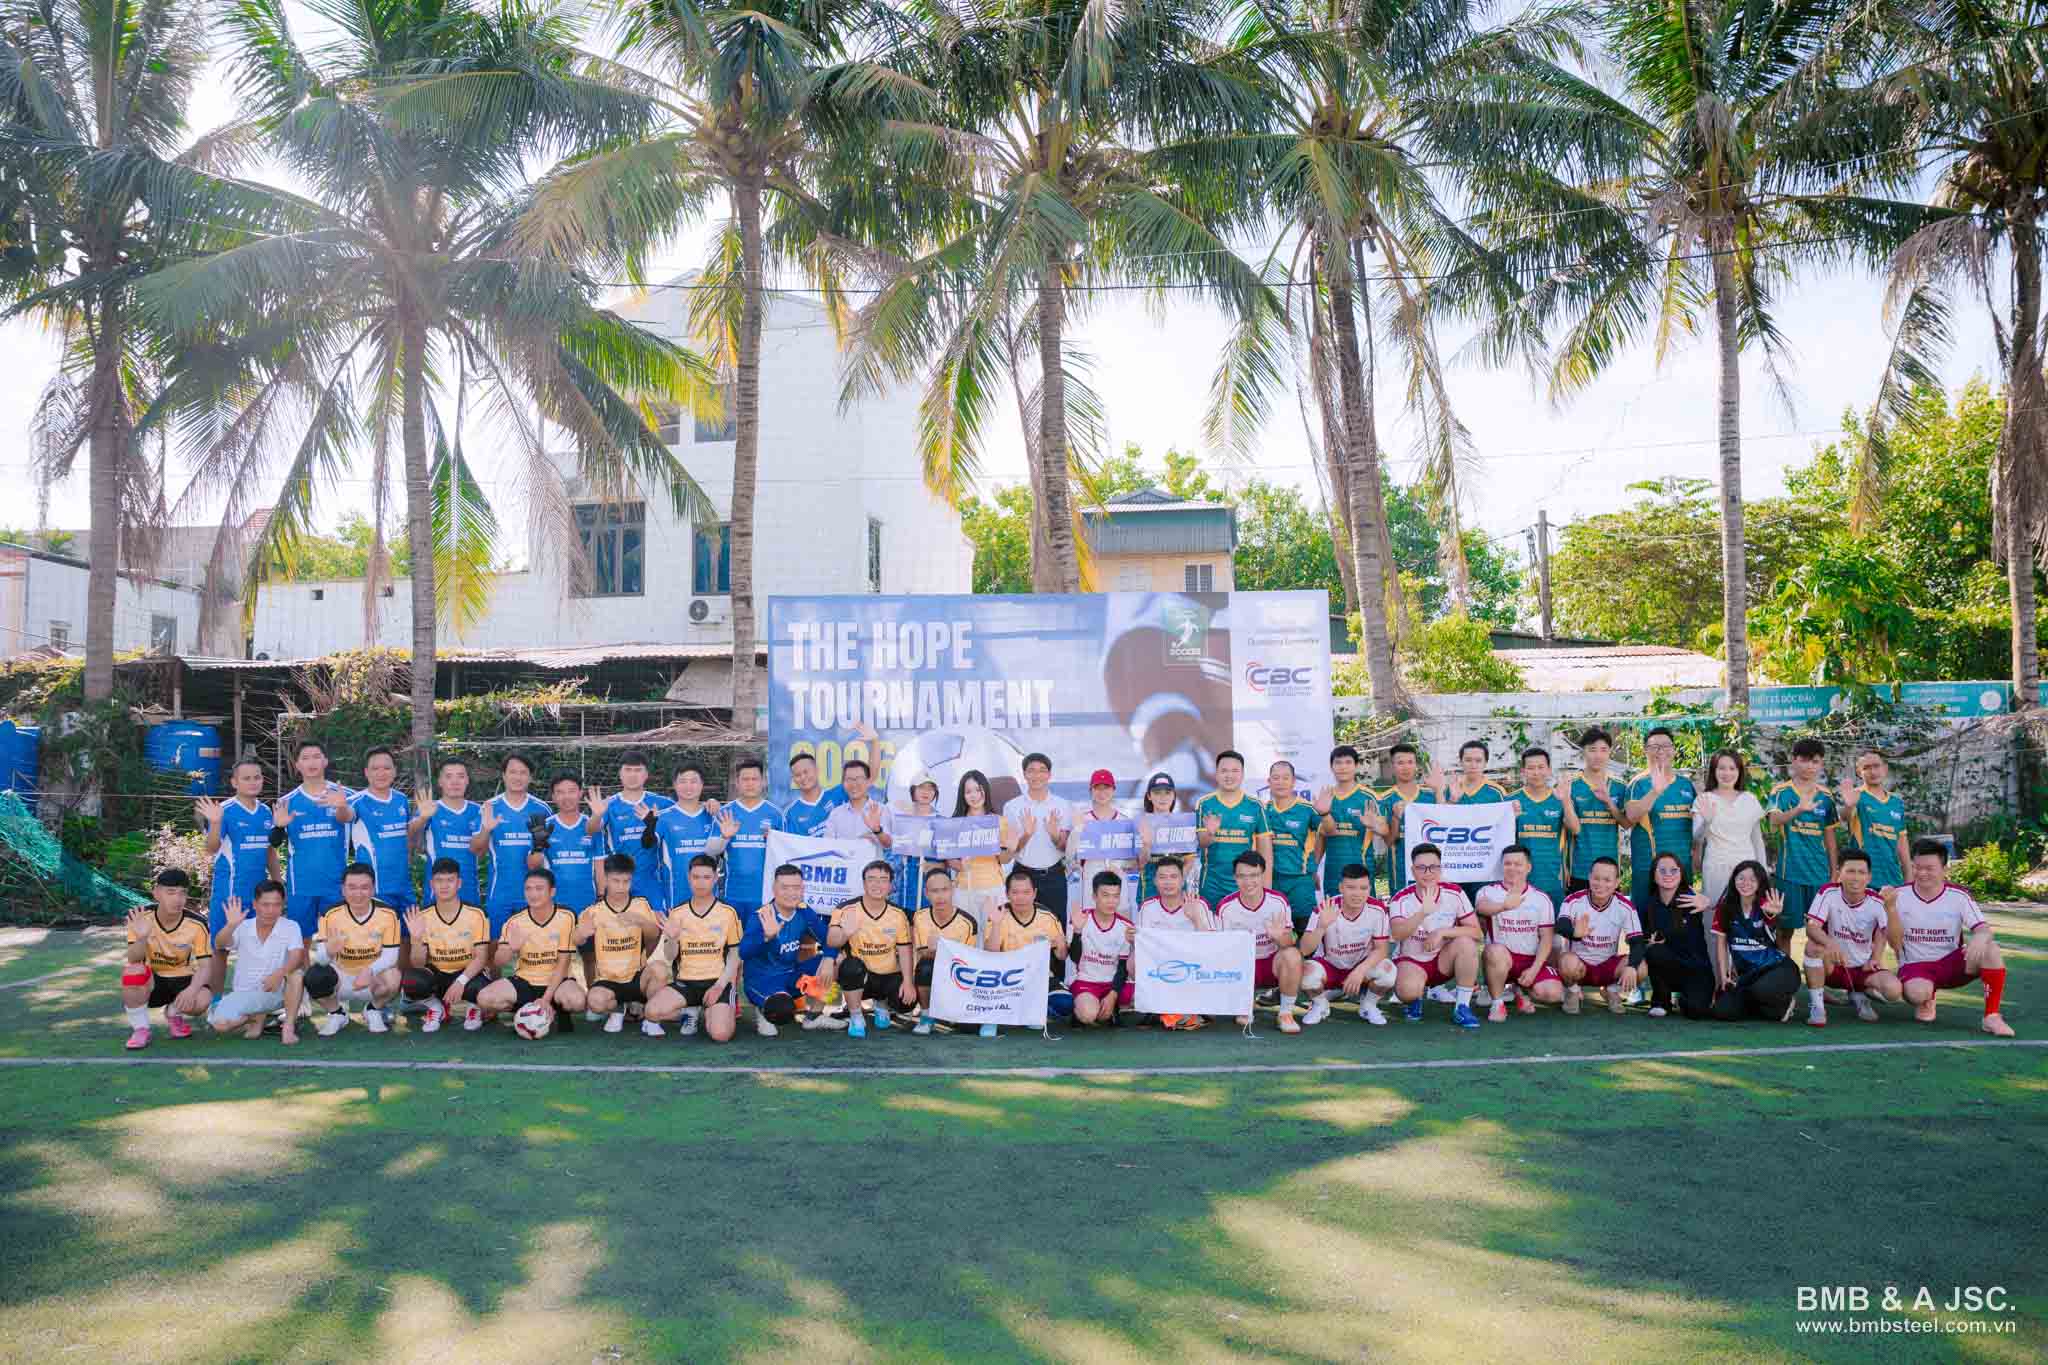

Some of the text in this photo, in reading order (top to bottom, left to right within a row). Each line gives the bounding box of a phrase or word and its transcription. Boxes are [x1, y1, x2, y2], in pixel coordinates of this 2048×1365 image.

[788, 621, 976, 672] THE HOPE
[1251, 668, 1313, 685] CBC
[788, 679, 1055, 729] TOURNAMENT
[1426, 826, 1493, 843] CBC
[1904, 935, 1955, 944] TOURNAMENT
[1910, 927, 1948, 936] THE HOPE
[955, 967, 1025, 989] CBC
